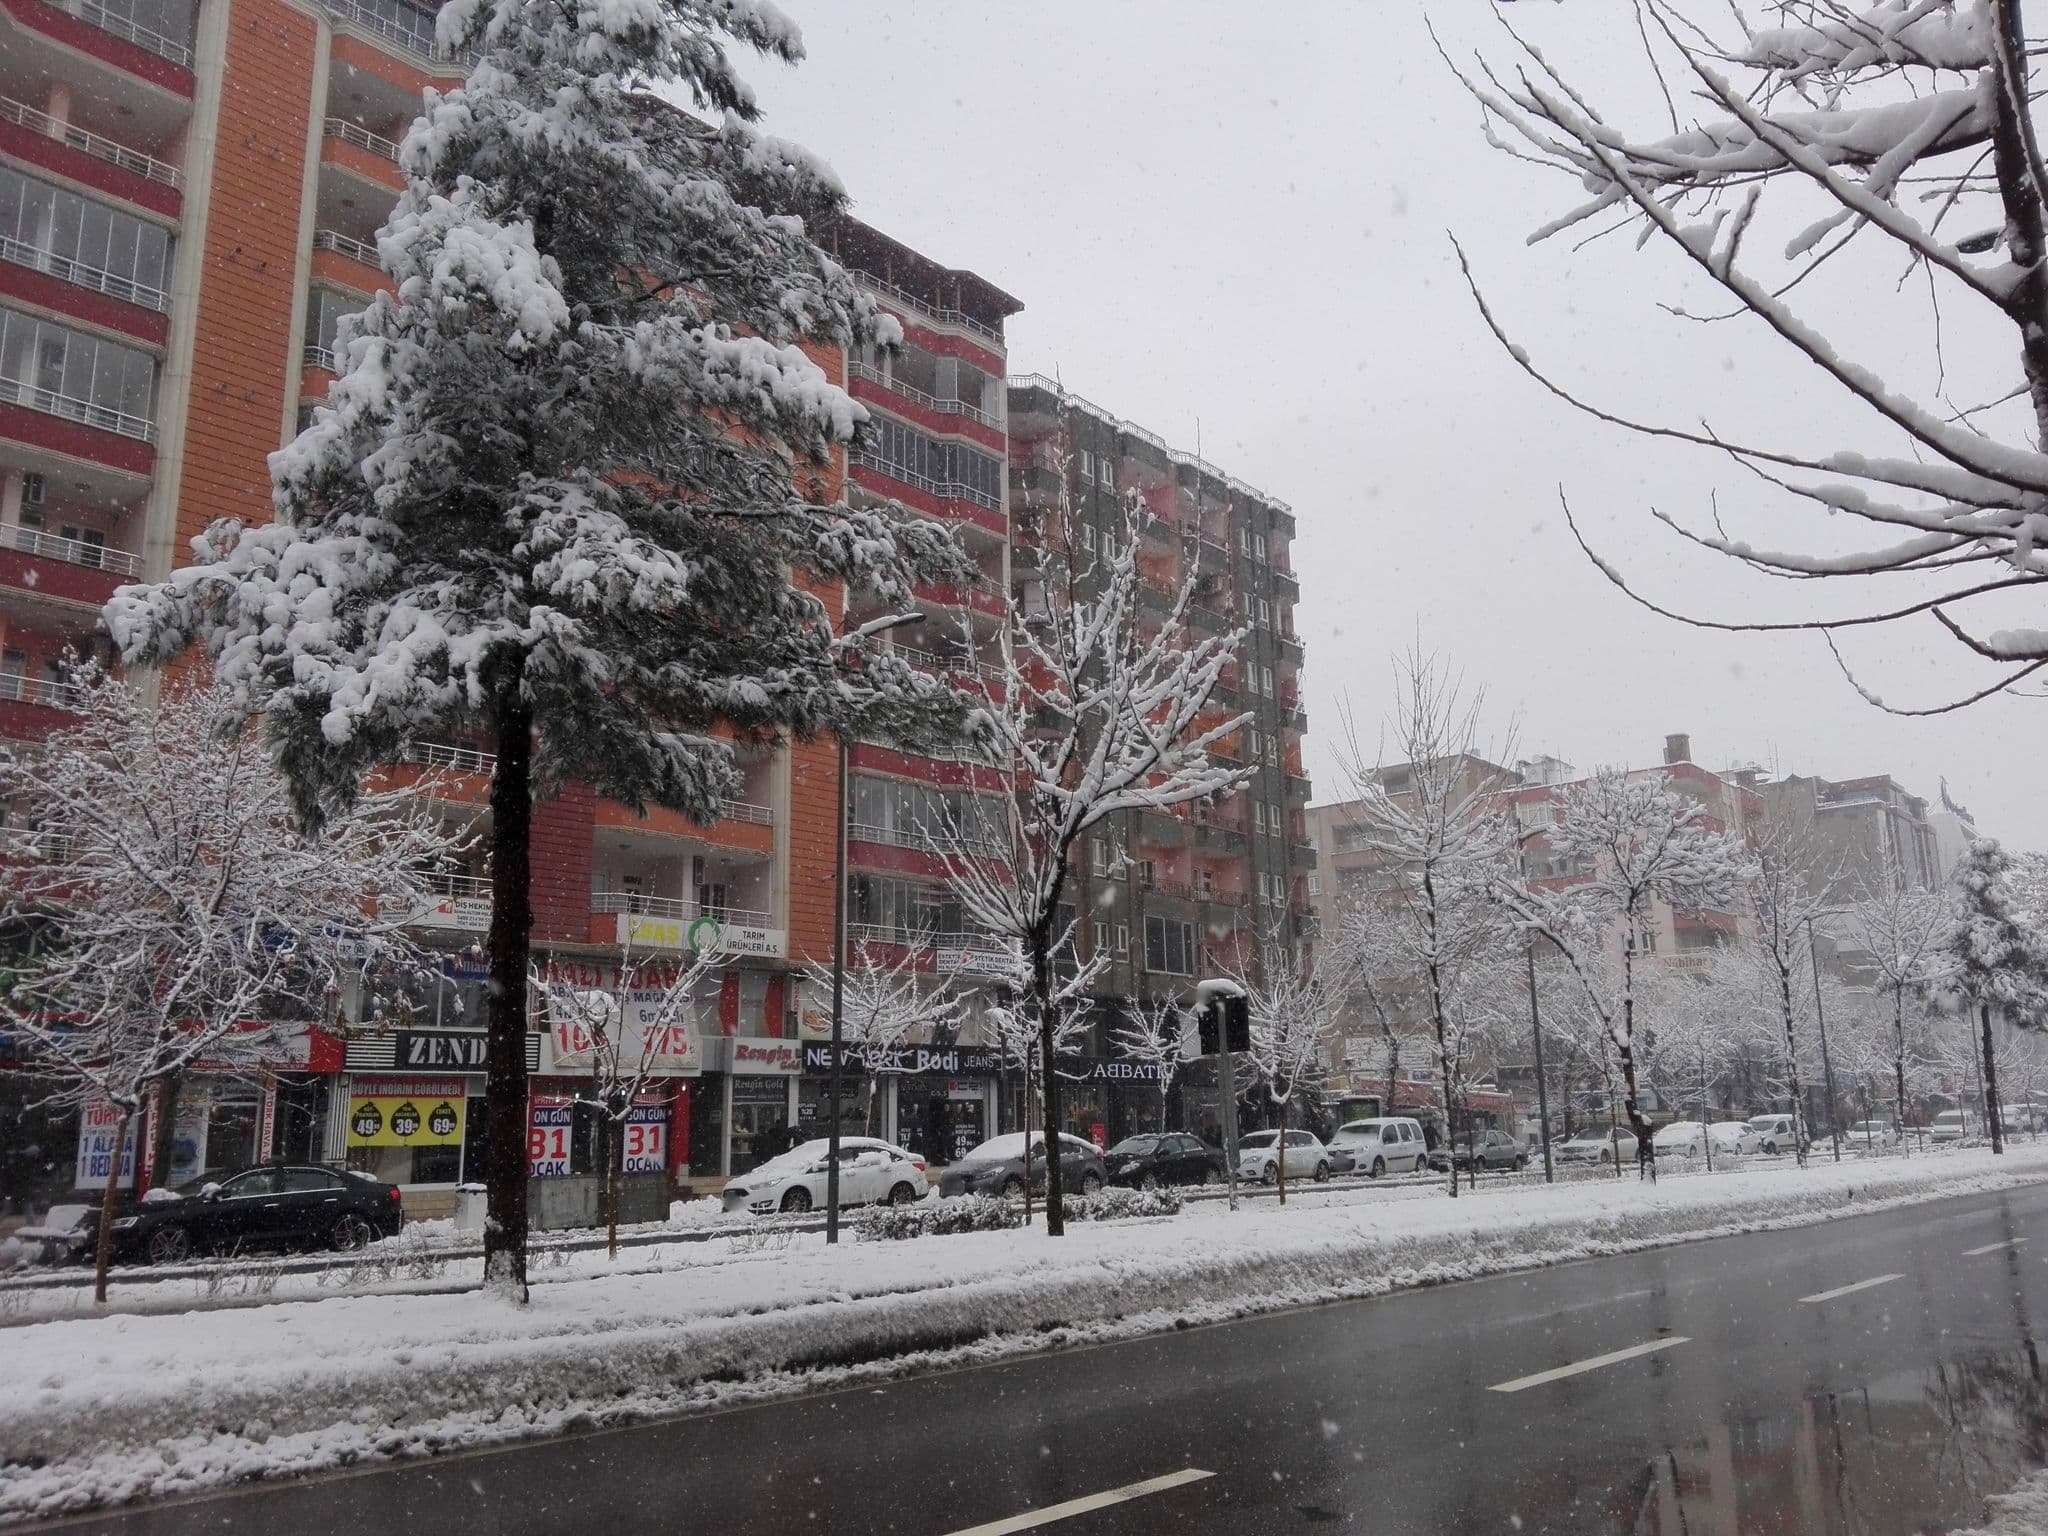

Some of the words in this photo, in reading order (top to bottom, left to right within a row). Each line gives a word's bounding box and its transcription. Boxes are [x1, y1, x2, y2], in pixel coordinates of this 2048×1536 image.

[742, 930, 765, 941] TARIM
[726, 939, 764, 951] ÜRÜNLERİ
[610, 964, 689, 991] FUAR
[735, 1044, 793, 1065] Rengin
[917, 1049, 959, 1071] Rodi
[964, 1055, 995, 1068] JEANS
[735, 1079, 762, 1092] Rengin
[765, 1079, 785, 1090] Gold
[647, 1106, 667, 1121] GÜN
[264, 1122, 273, 1148] HAVA
[627, 1125, 661, 1156] 31
[83, 1137, 89, 1152] 1
[81, 1156, 87, 1177] 1
[90, 1155, 131, 1177] BEDVA
[626, 1157, 662, 1171] OCAK
